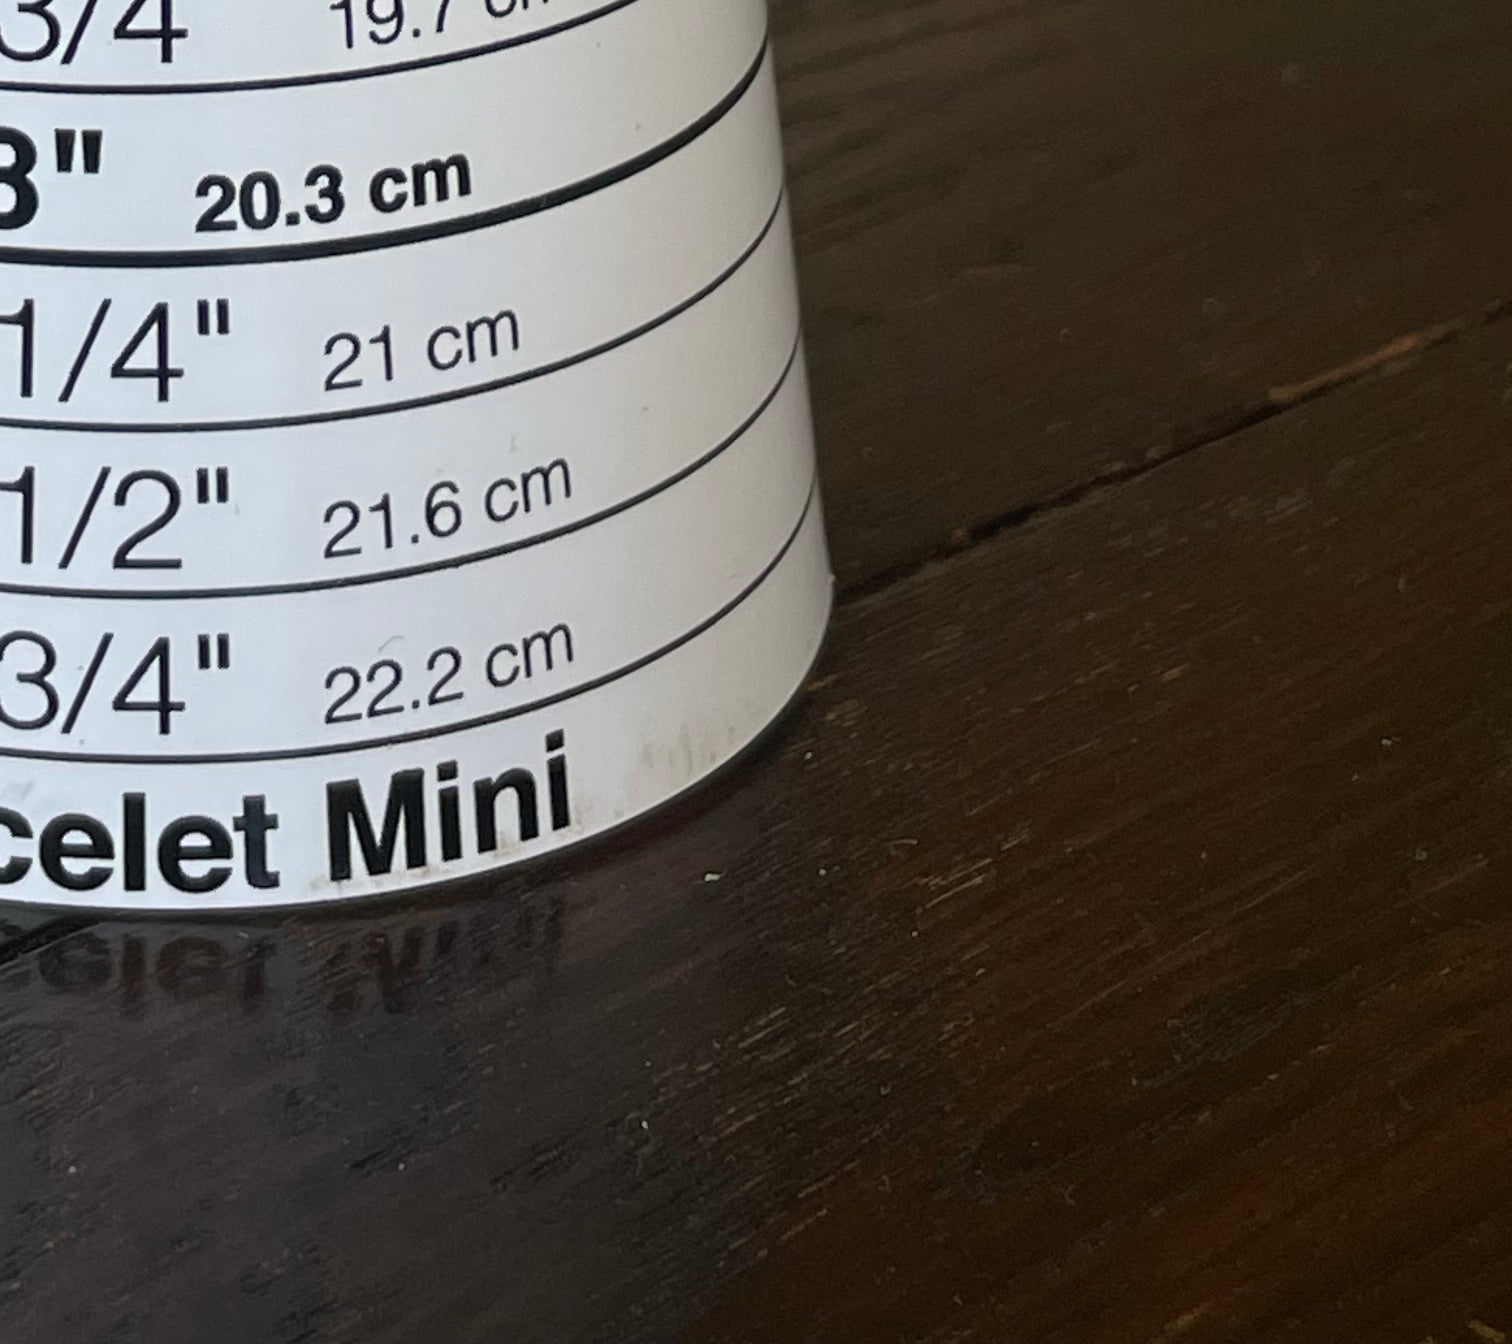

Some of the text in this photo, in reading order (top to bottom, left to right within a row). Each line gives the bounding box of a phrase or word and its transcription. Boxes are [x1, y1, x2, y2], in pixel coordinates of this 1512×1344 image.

[194, 164, 345, 233] 20.3
[369, 153, 472, 214] cm
[323, 324, 394, 393] 21
[426, 309, 520, 372] cm
[322, 480, 463, 560] 21.6
[484, 457, 572, 524] cm
[324, 646, 464, 726] 22.2
[485, 623, 574, 688] cm
[325, 728, 571, 882] Mini
